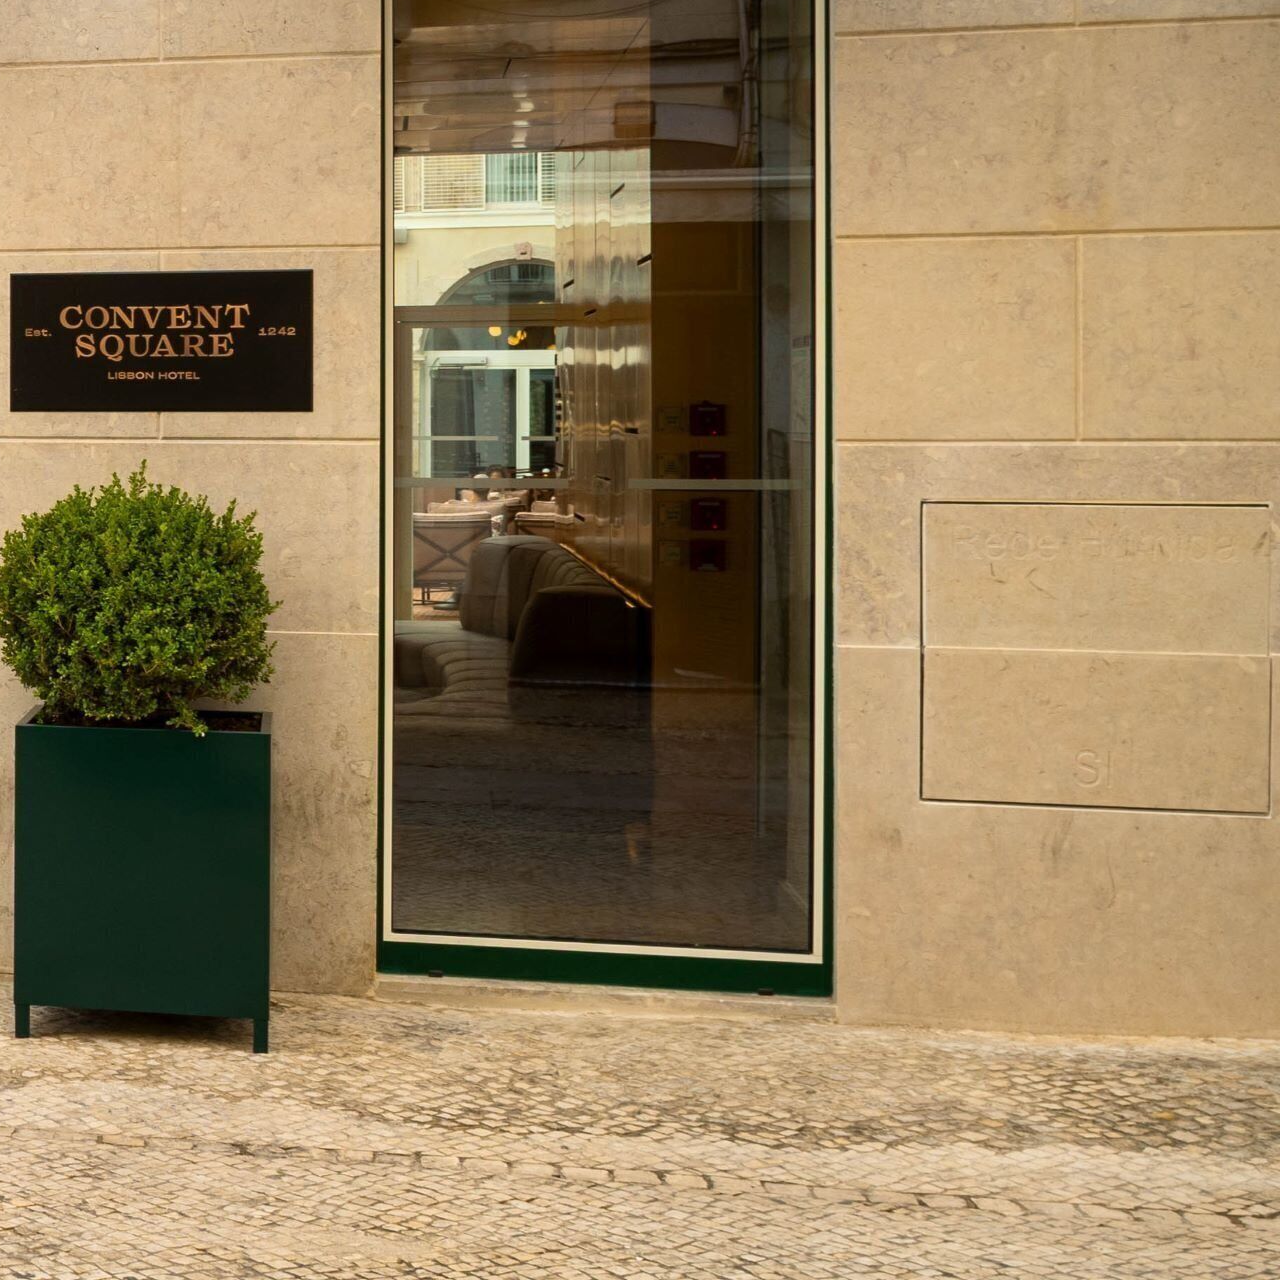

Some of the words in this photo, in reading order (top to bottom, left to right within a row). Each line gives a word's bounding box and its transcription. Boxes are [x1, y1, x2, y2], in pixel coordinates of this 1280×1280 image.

[58, 303, 251, 330] CONVENT
[24, 327, 53, 338] Est.
[258, 325, 297, 337] 1242
[74, 332, 236, 363] SQUARE
[107, 370, 155, 381] LISBON
[159, 370, 201, 381] HOTEL
